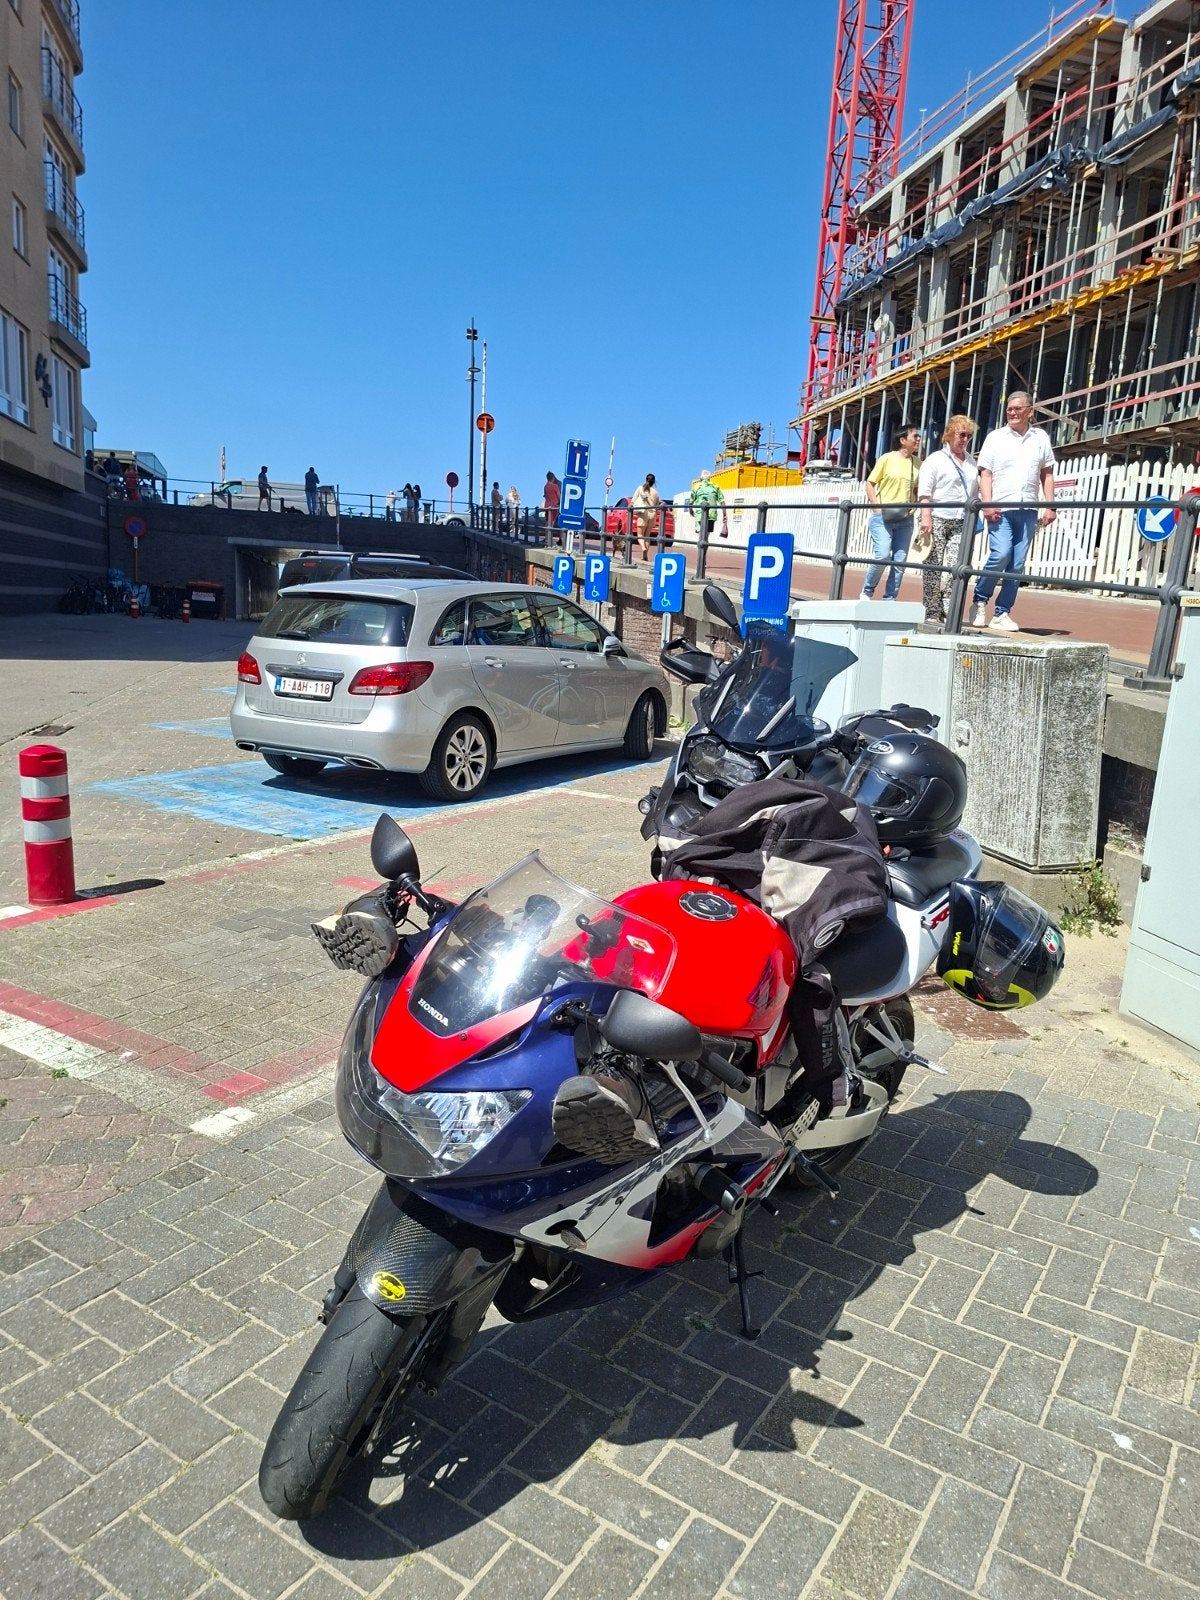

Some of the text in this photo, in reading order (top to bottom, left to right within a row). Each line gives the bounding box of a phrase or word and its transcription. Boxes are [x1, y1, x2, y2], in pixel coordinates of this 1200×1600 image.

[563, 483, 583, 510] P
[557, 559, 570, 579] P
[589, 558, 604, 583] P
[659, 557, 678, 588] P
[749, 545, 785, 600] P
[417, 997, 449, 1027] HONDA
